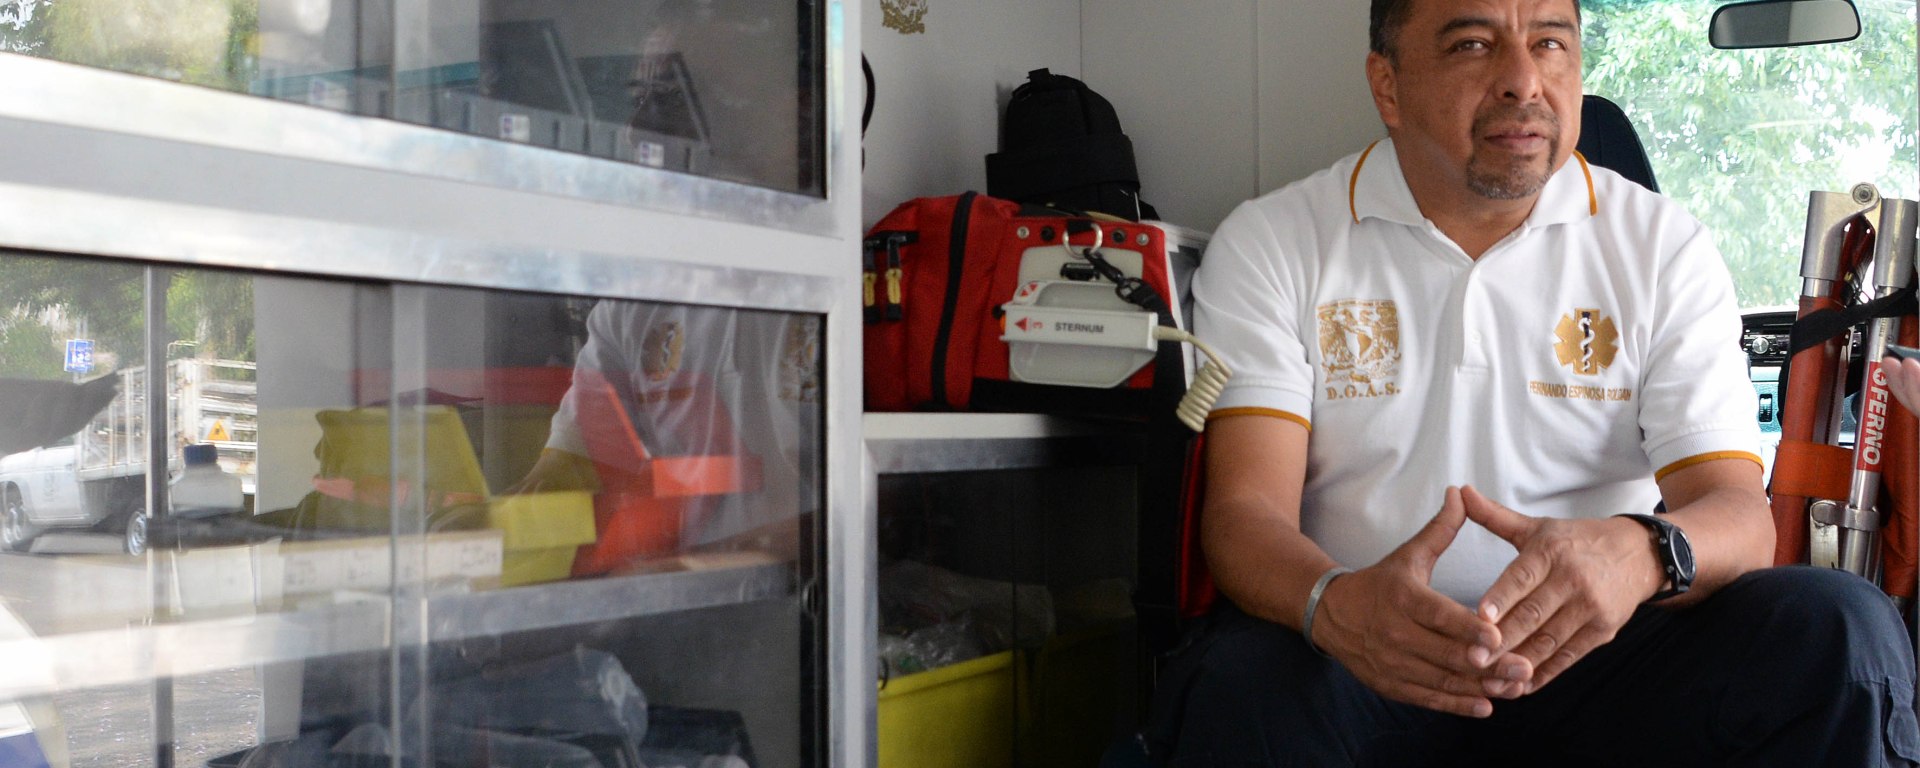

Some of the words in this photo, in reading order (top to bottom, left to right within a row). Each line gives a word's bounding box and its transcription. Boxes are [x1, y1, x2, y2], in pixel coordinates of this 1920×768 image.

[1055, 322, 1104, 333] STERNUM
[1530, 381, 1567, 398] FERNANDO
[1568, 386, 1604, 401] ESPINOSA
[1862, 386, 1889, 465] FERNO
